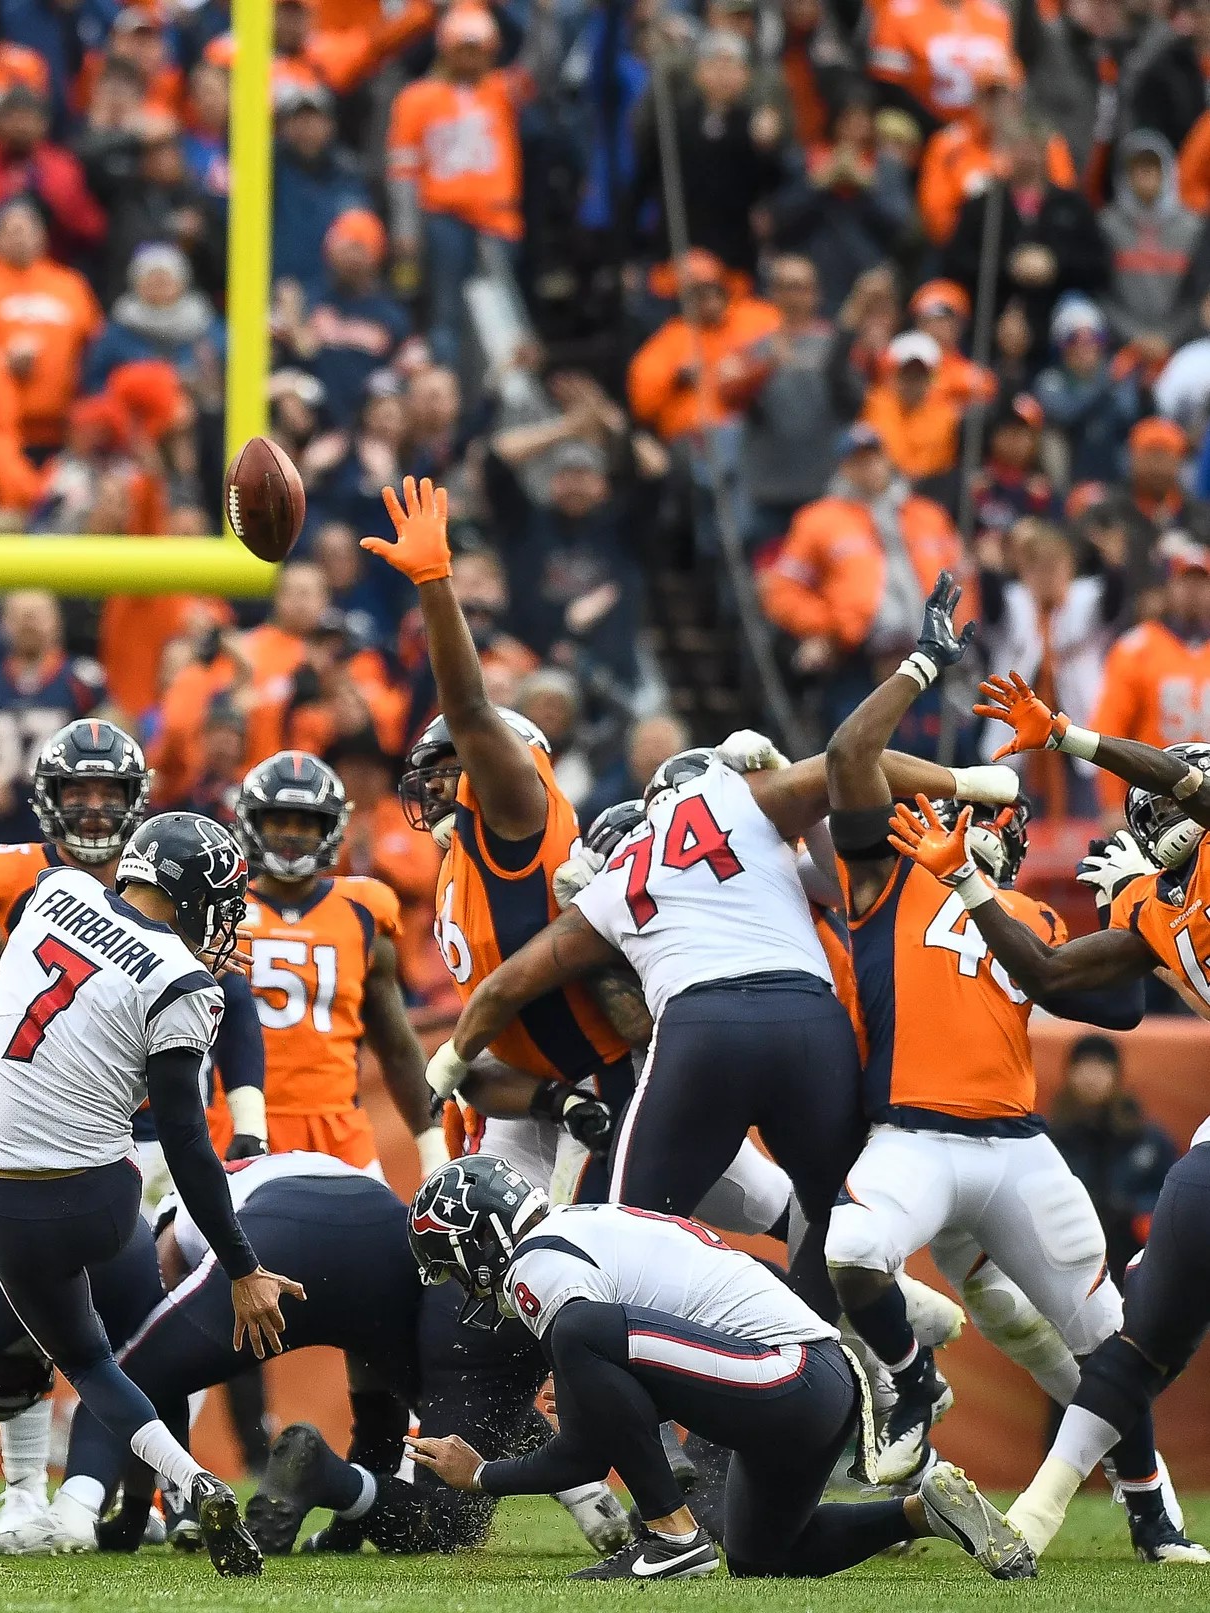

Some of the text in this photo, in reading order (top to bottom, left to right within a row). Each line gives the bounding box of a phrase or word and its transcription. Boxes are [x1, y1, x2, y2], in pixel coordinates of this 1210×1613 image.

[122, 864, 149, 873] TEXANS
[606, 793, 746, 931] 74
[34, 888, 165, 985] FAIRBAIRN
[1169, 898, 1203, 929] BRONCOS
[0, 933, 103, 1063] 7
[251, 938, 337, 1033] 51
[514, 1282, 541, 1318] 8
